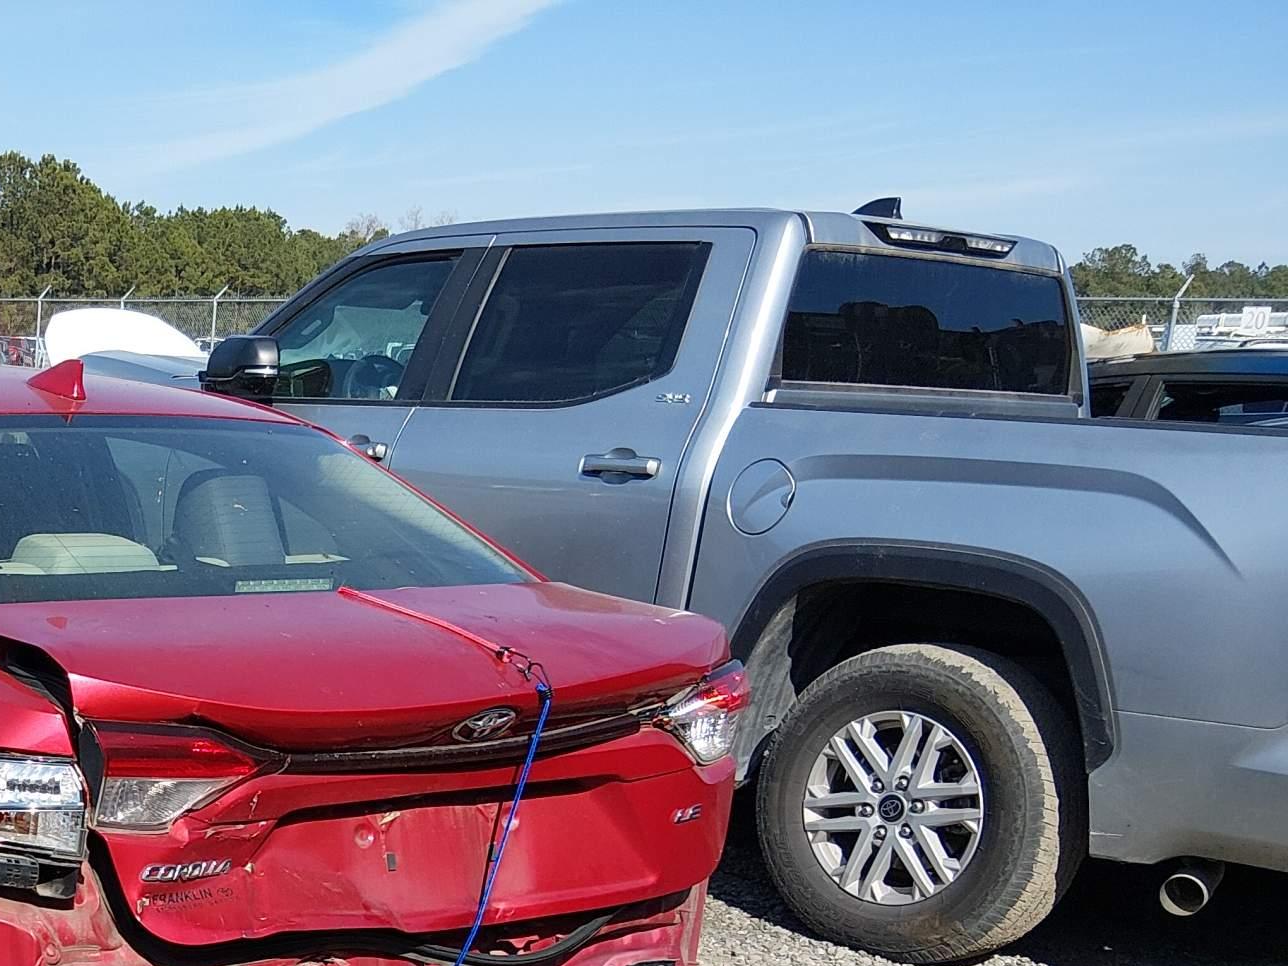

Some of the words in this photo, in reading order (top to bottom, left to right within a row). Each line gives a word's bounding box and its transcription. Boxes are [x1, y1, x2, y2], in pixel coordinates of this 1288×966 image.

[1244, 310, 1266, 330] 20
[140, 859, 232, 882] COROLLA
[152, 888, 213, 906] FRANKLIN
